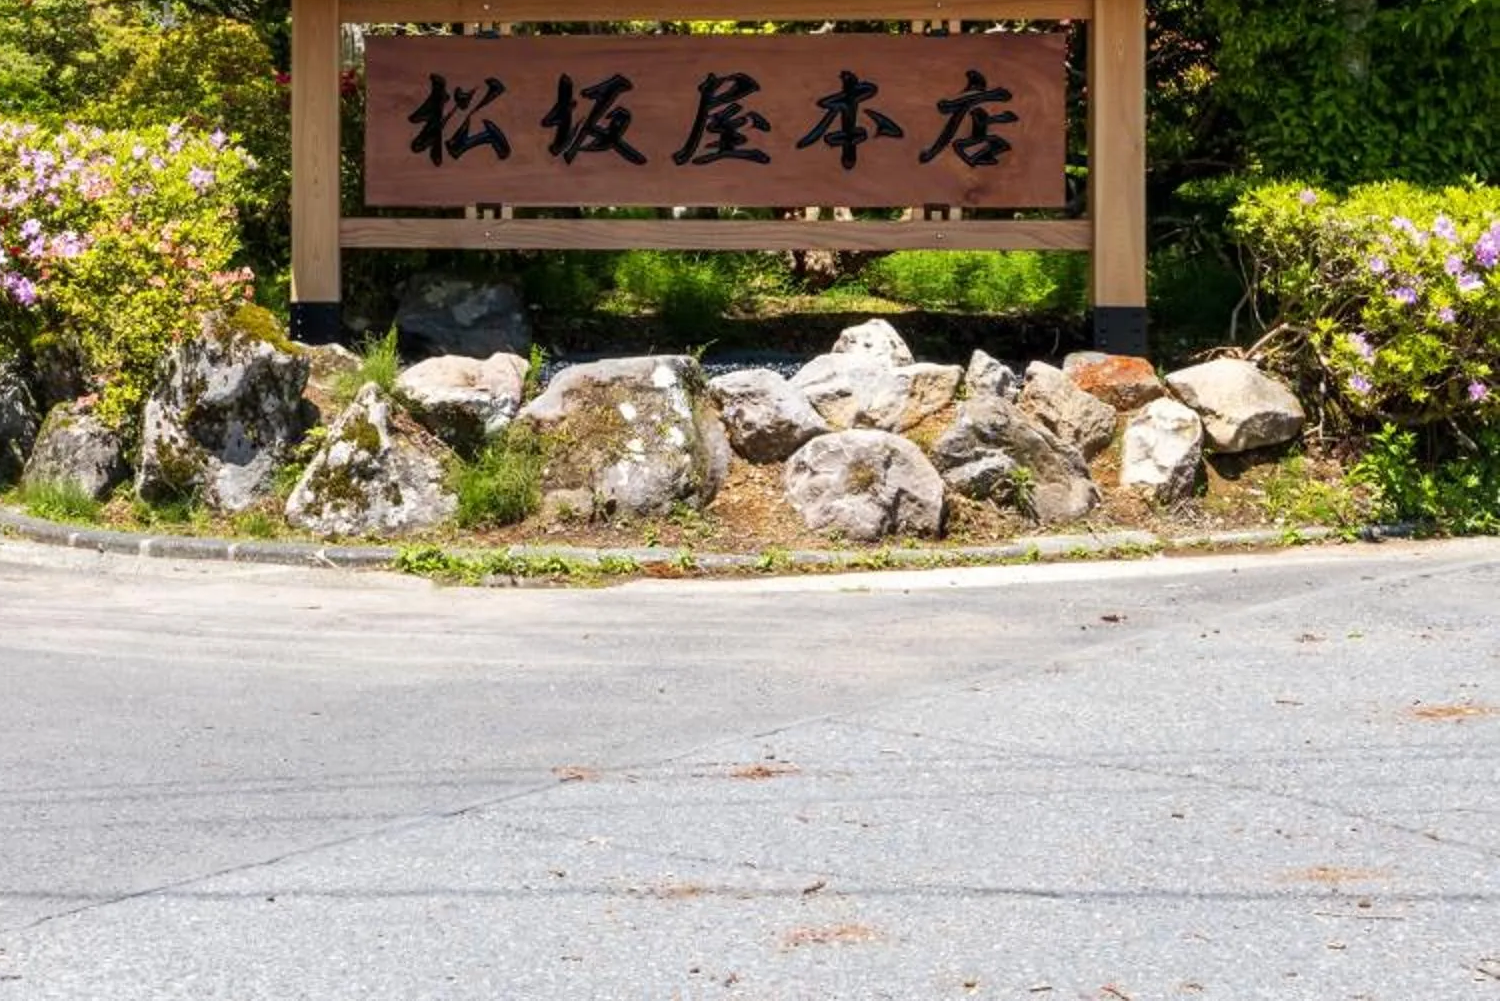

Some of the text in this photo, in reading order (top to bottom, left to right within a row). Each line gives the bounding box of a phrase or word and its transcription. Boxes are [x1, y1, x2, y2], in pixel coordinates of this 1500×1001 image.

[408, 69, 1018, 170] 松坂屋本店
